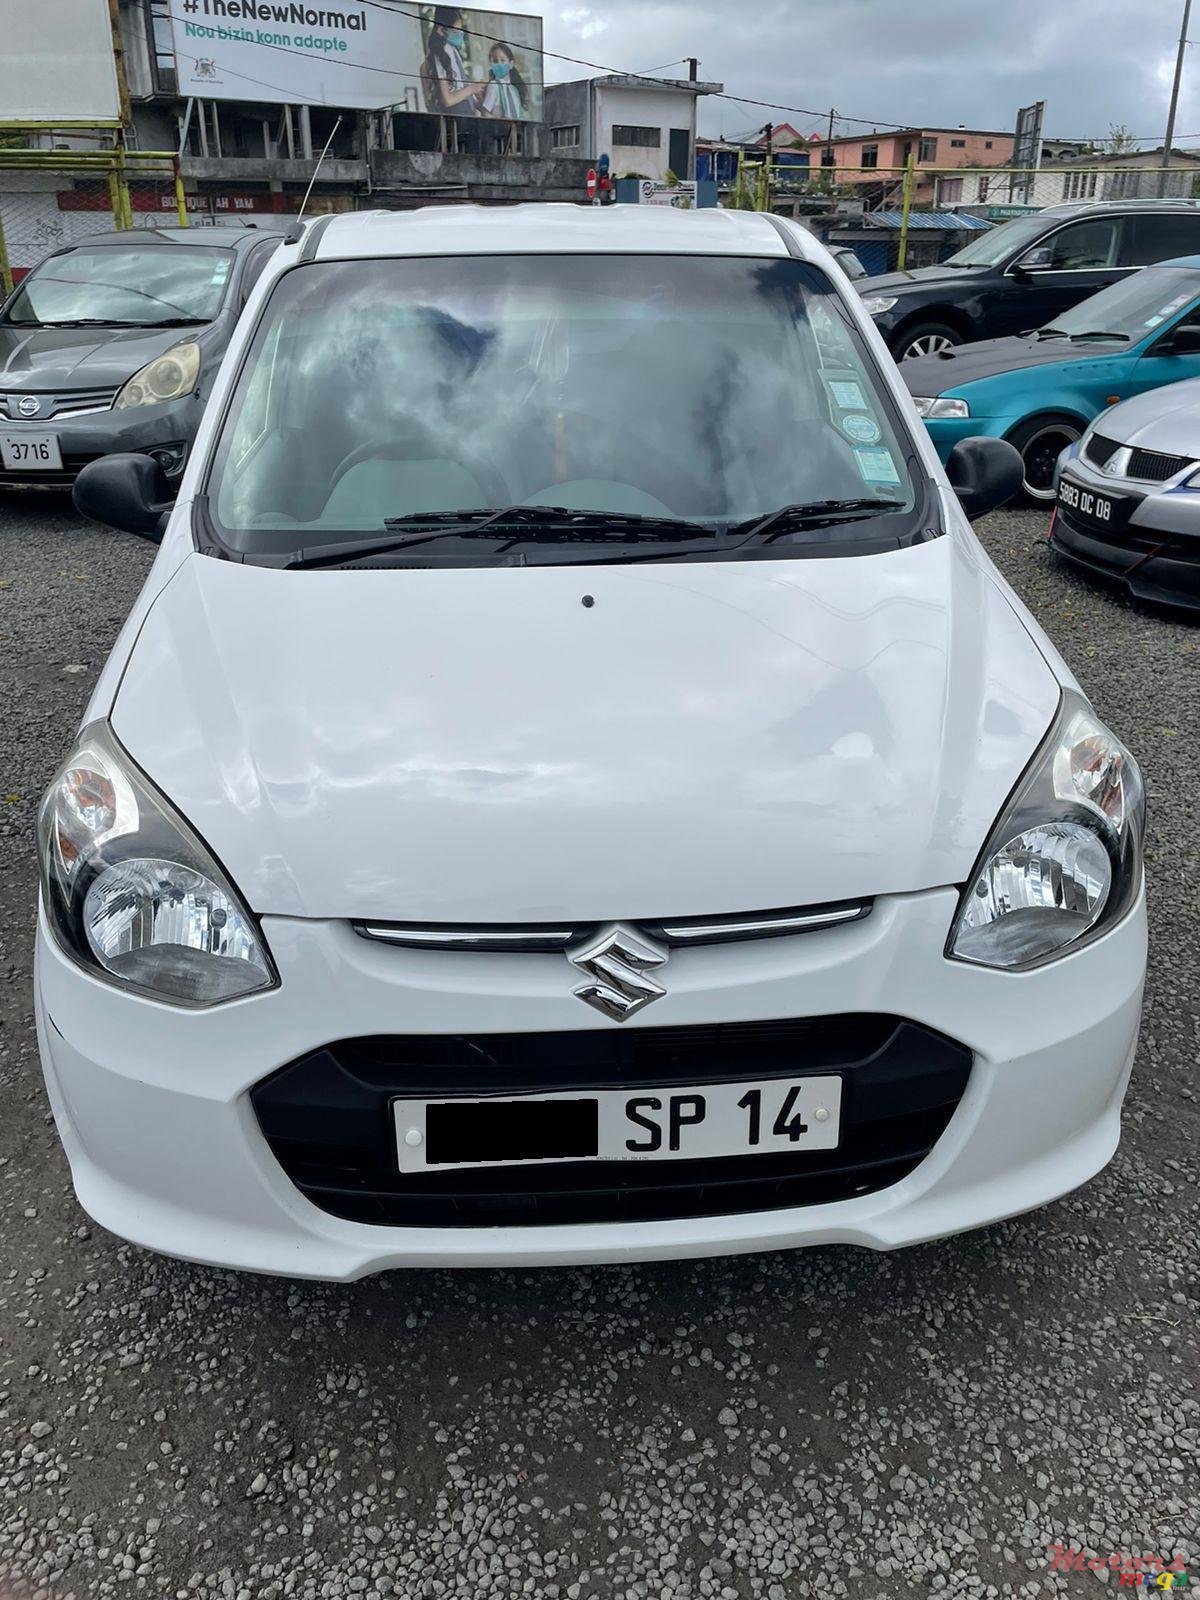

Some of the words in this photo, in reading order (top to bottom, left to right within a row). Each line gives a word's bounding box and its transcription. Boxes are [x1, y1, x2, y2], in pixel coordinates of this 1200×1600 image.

[183, 0, 367, 31] #TheNewNormal
[185, 22, 214, 38] Nou
[217, 25, 253, 42] bizin
[256, 29, 291, 46] konn
[293, 34, 348, 53] adapte
[234, 198, 254, 208] YAM
[11, 443, 49, 460] 3716
[1095, 498, 1111, 521] 08
[625, 1094, 706, 1152] SP
[737, 1085, 808, 1145] 14
